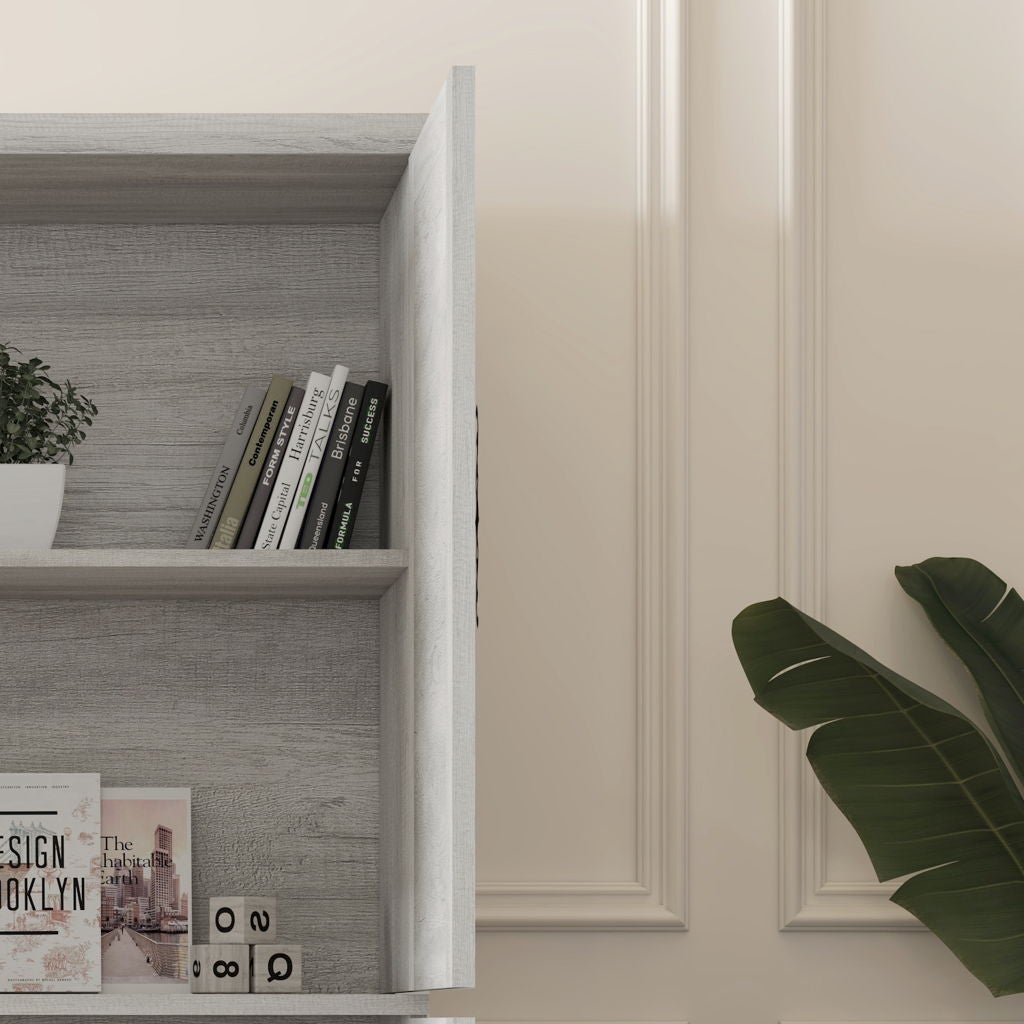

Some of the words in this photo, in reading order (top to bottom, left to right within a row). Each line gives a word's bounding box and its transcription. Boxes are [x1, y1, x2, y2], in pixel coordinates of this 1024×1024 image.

[236, 404, 253, 436] Columbia
[262, 448, 282, 487] FORM
[276, 405, 295, 447] STYLE
[289, 387, 326, 461] Harrisburg
[296, 472, 314, 509] TED
[308, 388, 341, 462] TALKS
[330, 396, 358, 461] Brisbane
[194, 465, 231, 543] WASHINGTON
[335, 501, 354, 549] FORMULA
[351, 459, 363, 483] FOR
[360, 397, 379, 444] SUCCESS
[261, 523, 278, 549] State
[271, 482, 292, 521] Capital
[100, 835, 133, 851] The
